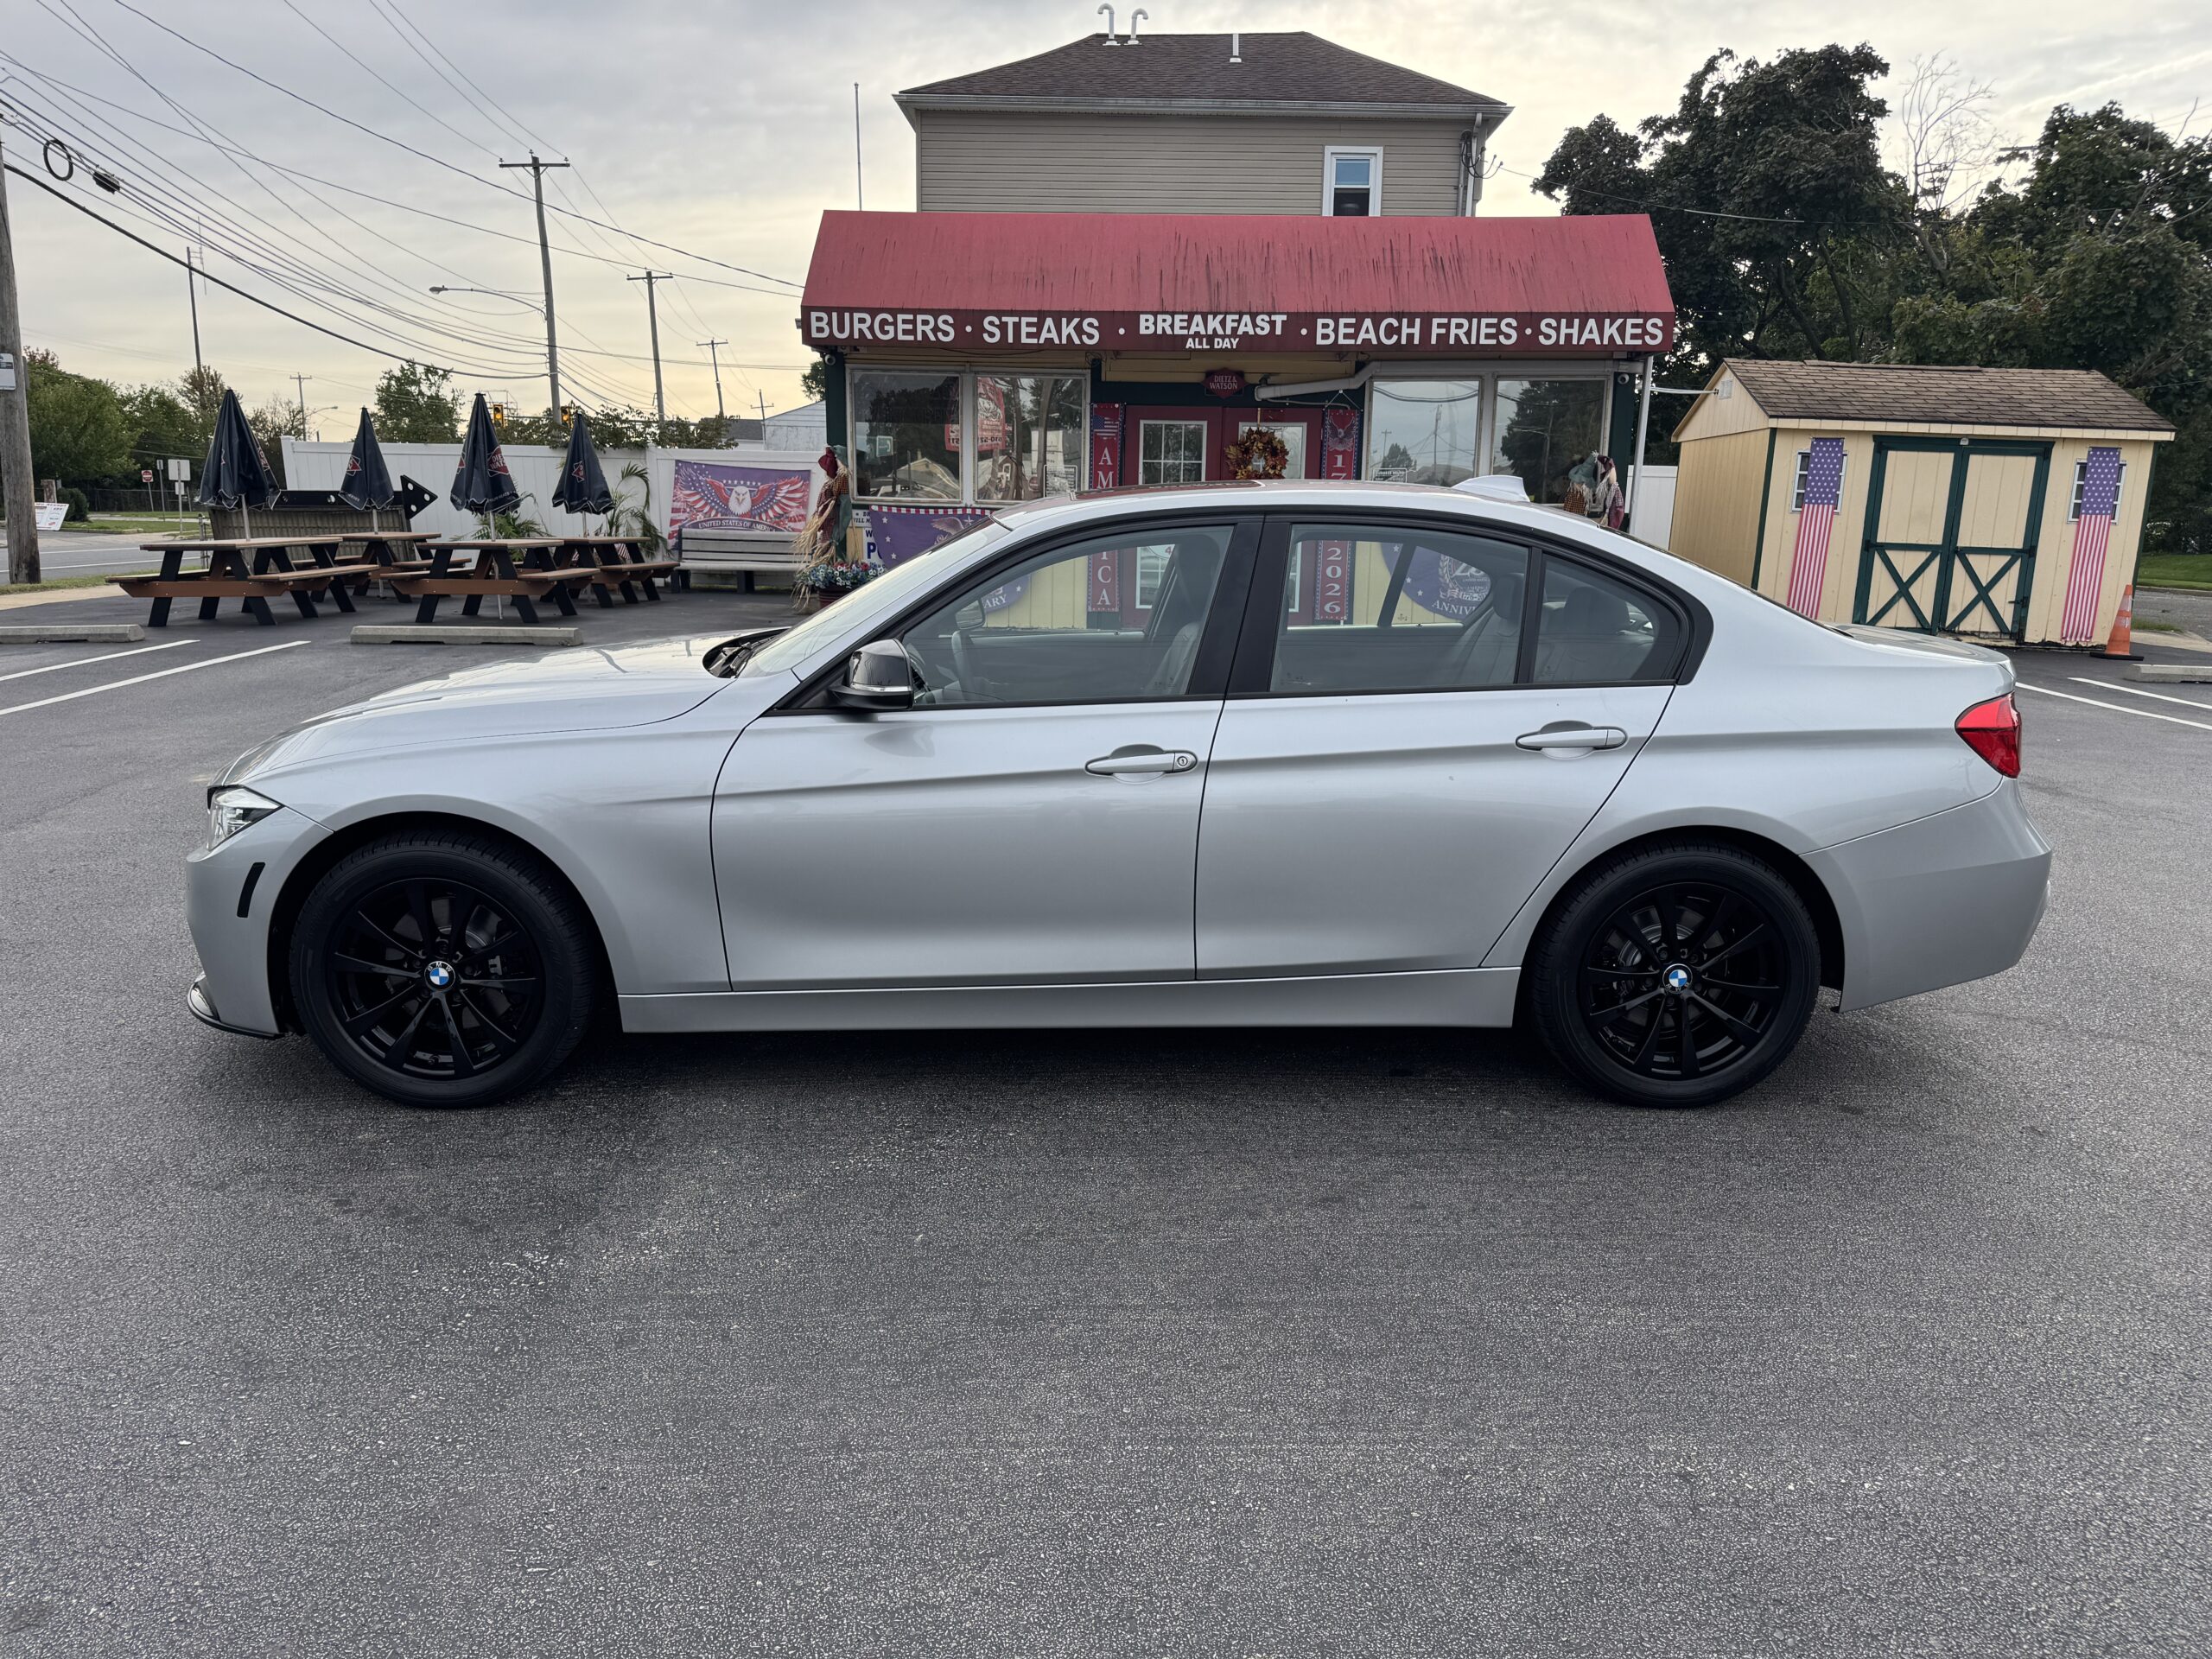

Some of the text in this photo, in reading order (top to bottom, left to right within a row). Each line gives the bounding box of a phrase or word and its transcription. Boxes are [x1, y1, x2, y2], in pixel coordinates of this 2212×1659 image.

[810, 311, 955, 342] BURGERS
[982, 315, 1100, 345] STEAKS
[1139, 314, 1287, 335] BREAKFAST
[1316, 317, 1518, 346] BEACH FRIES
[1538, 317, 1663, 346] SHAKES
[1185, 337, 1240, 349] ALL DAY
[492, 454, 505, 462] DIE
[698, 520, 721, 529] UNITED
[1324, 547, 1343, 613] 2026
[983, 594, 1007, 609] ARY
[1432, 600, 1476, 615] ANNIV
